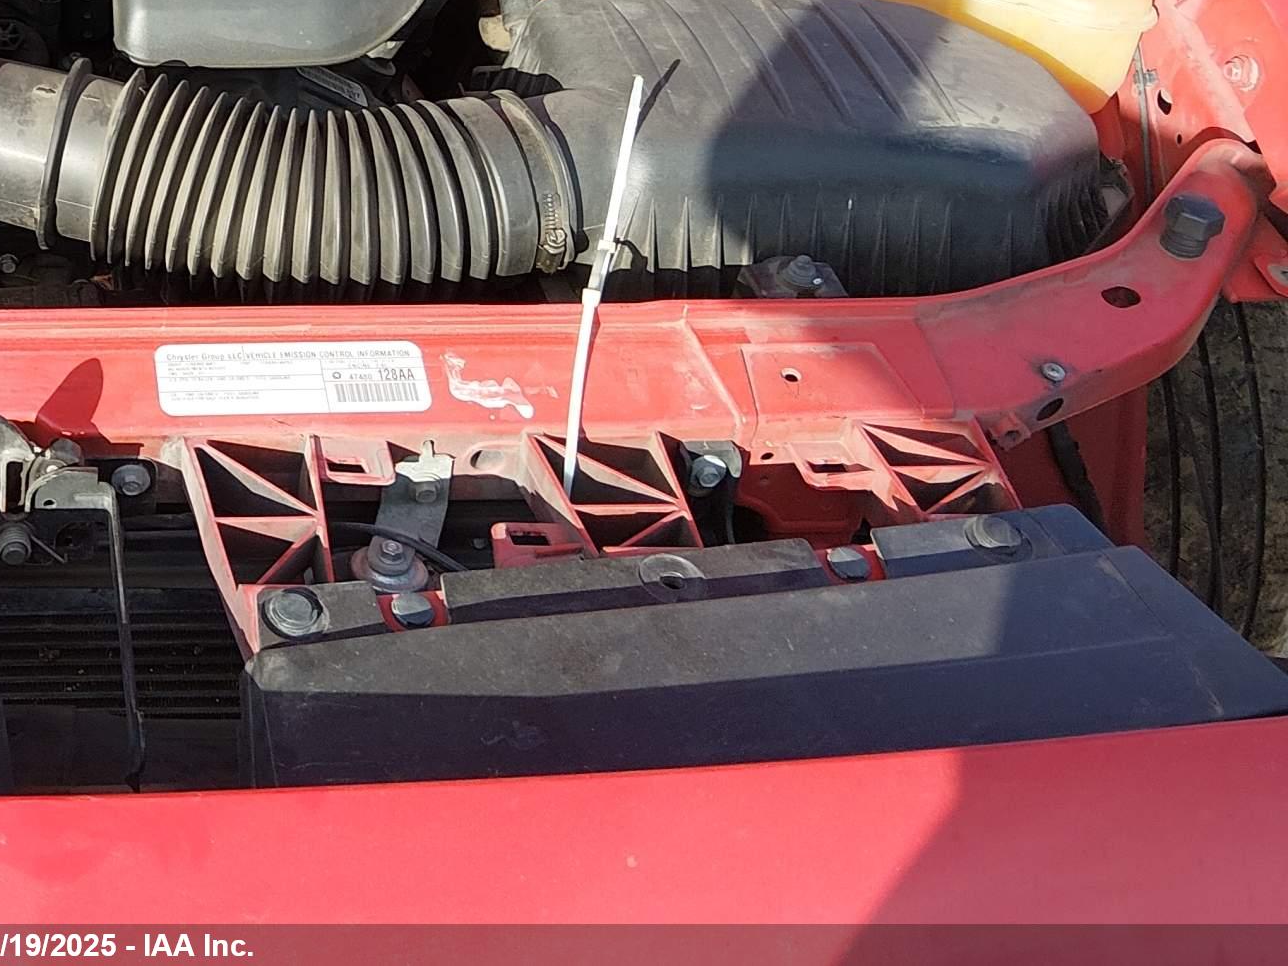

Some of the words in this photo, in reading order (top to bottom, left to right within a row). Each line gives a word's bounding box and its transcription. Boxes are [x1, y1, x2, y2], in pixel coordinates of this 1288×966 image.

[166, 353, 199, 362] Chrysler
[201, 353, 225, 362] Group
[244, 351, 276, 359] VEHICLE
[280, 350, 316, 359] EMISSION
[319, 350, 354, 358] CONTROL
[357, 349, 410, 357] INFORMATION
[377, 368, 415, 381] 128AA
